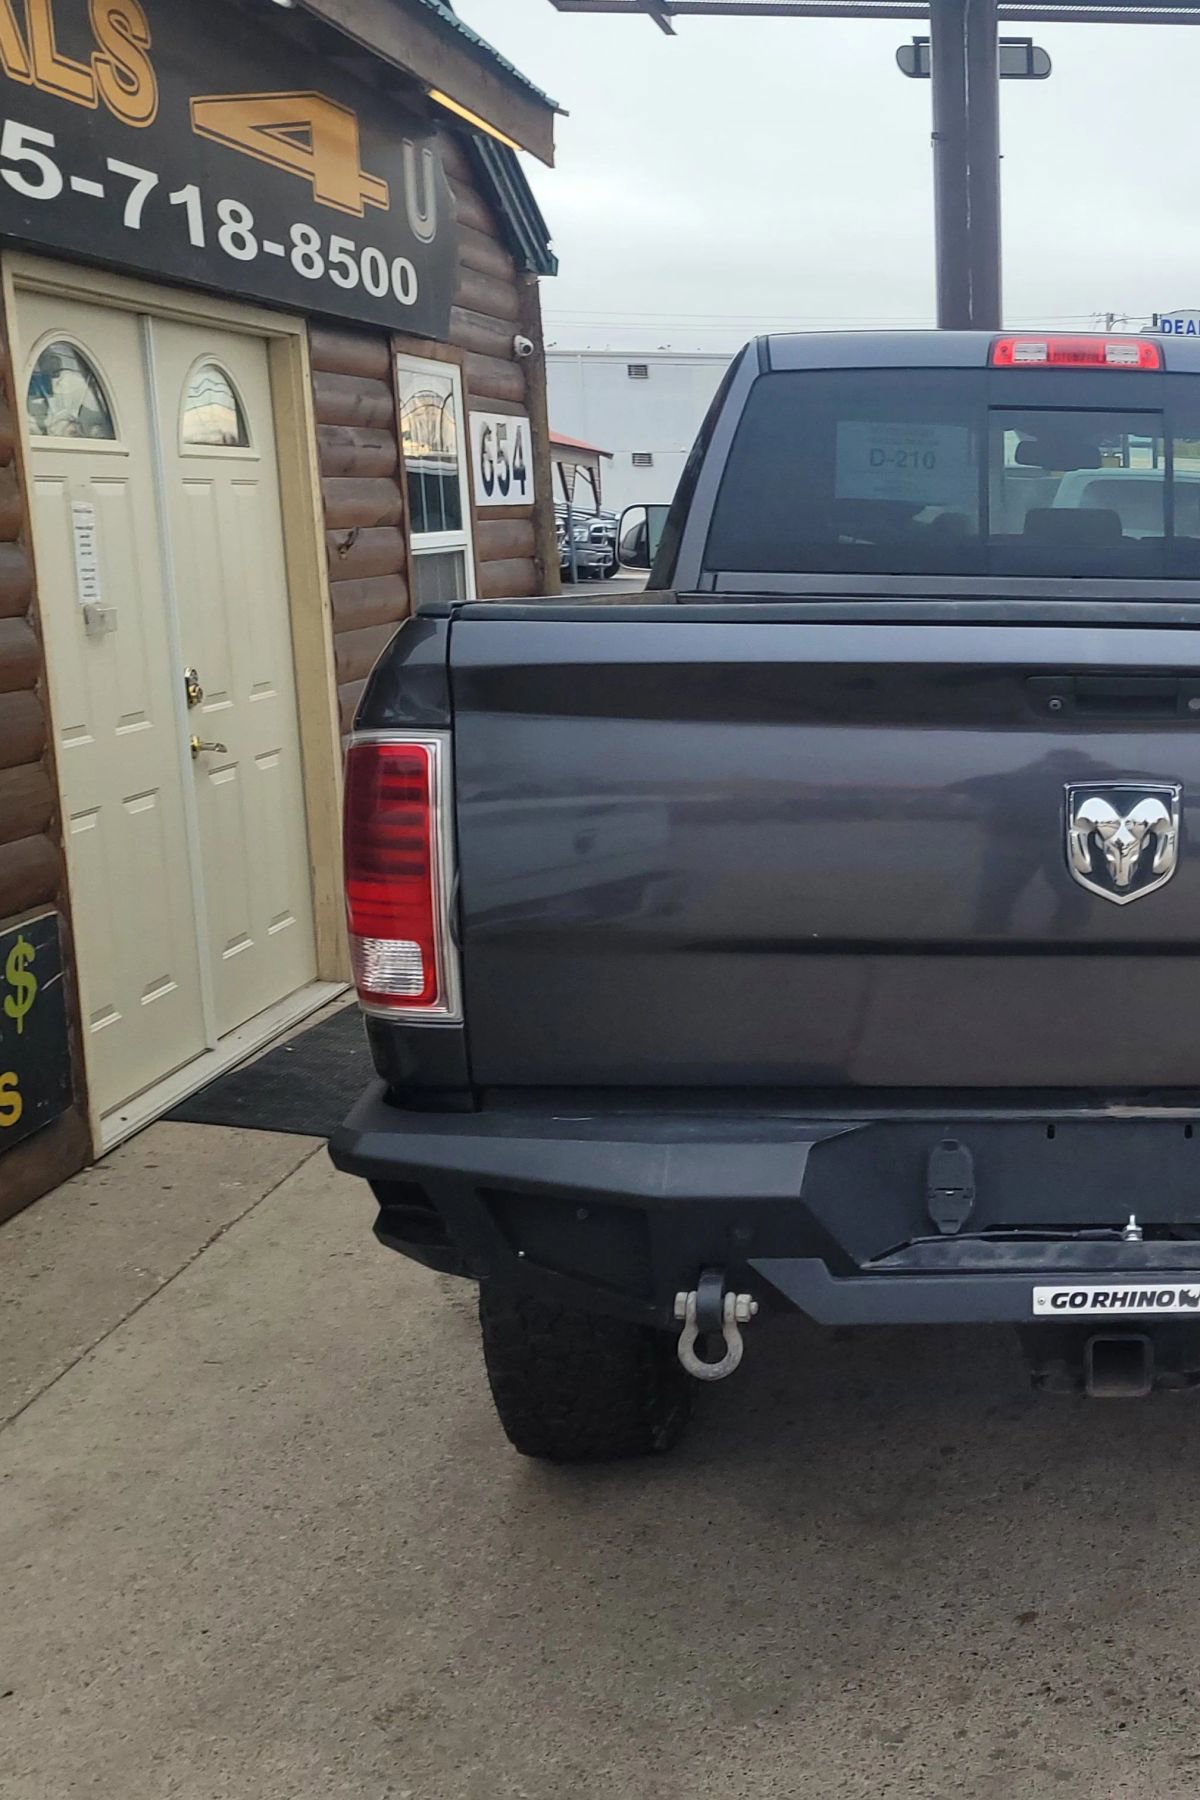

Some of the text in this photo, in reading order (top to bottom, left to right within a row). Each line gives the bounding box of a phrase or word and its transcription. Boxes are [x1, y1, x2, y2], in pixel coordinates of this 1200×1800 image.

[0, 119, 418, 306] 5-718-8500
[189, 91, 389, 217] 4
[403, 138, 437, 243] U
[480, 421, 526, 497] 654
[869, 447, 937, 470] D-210
